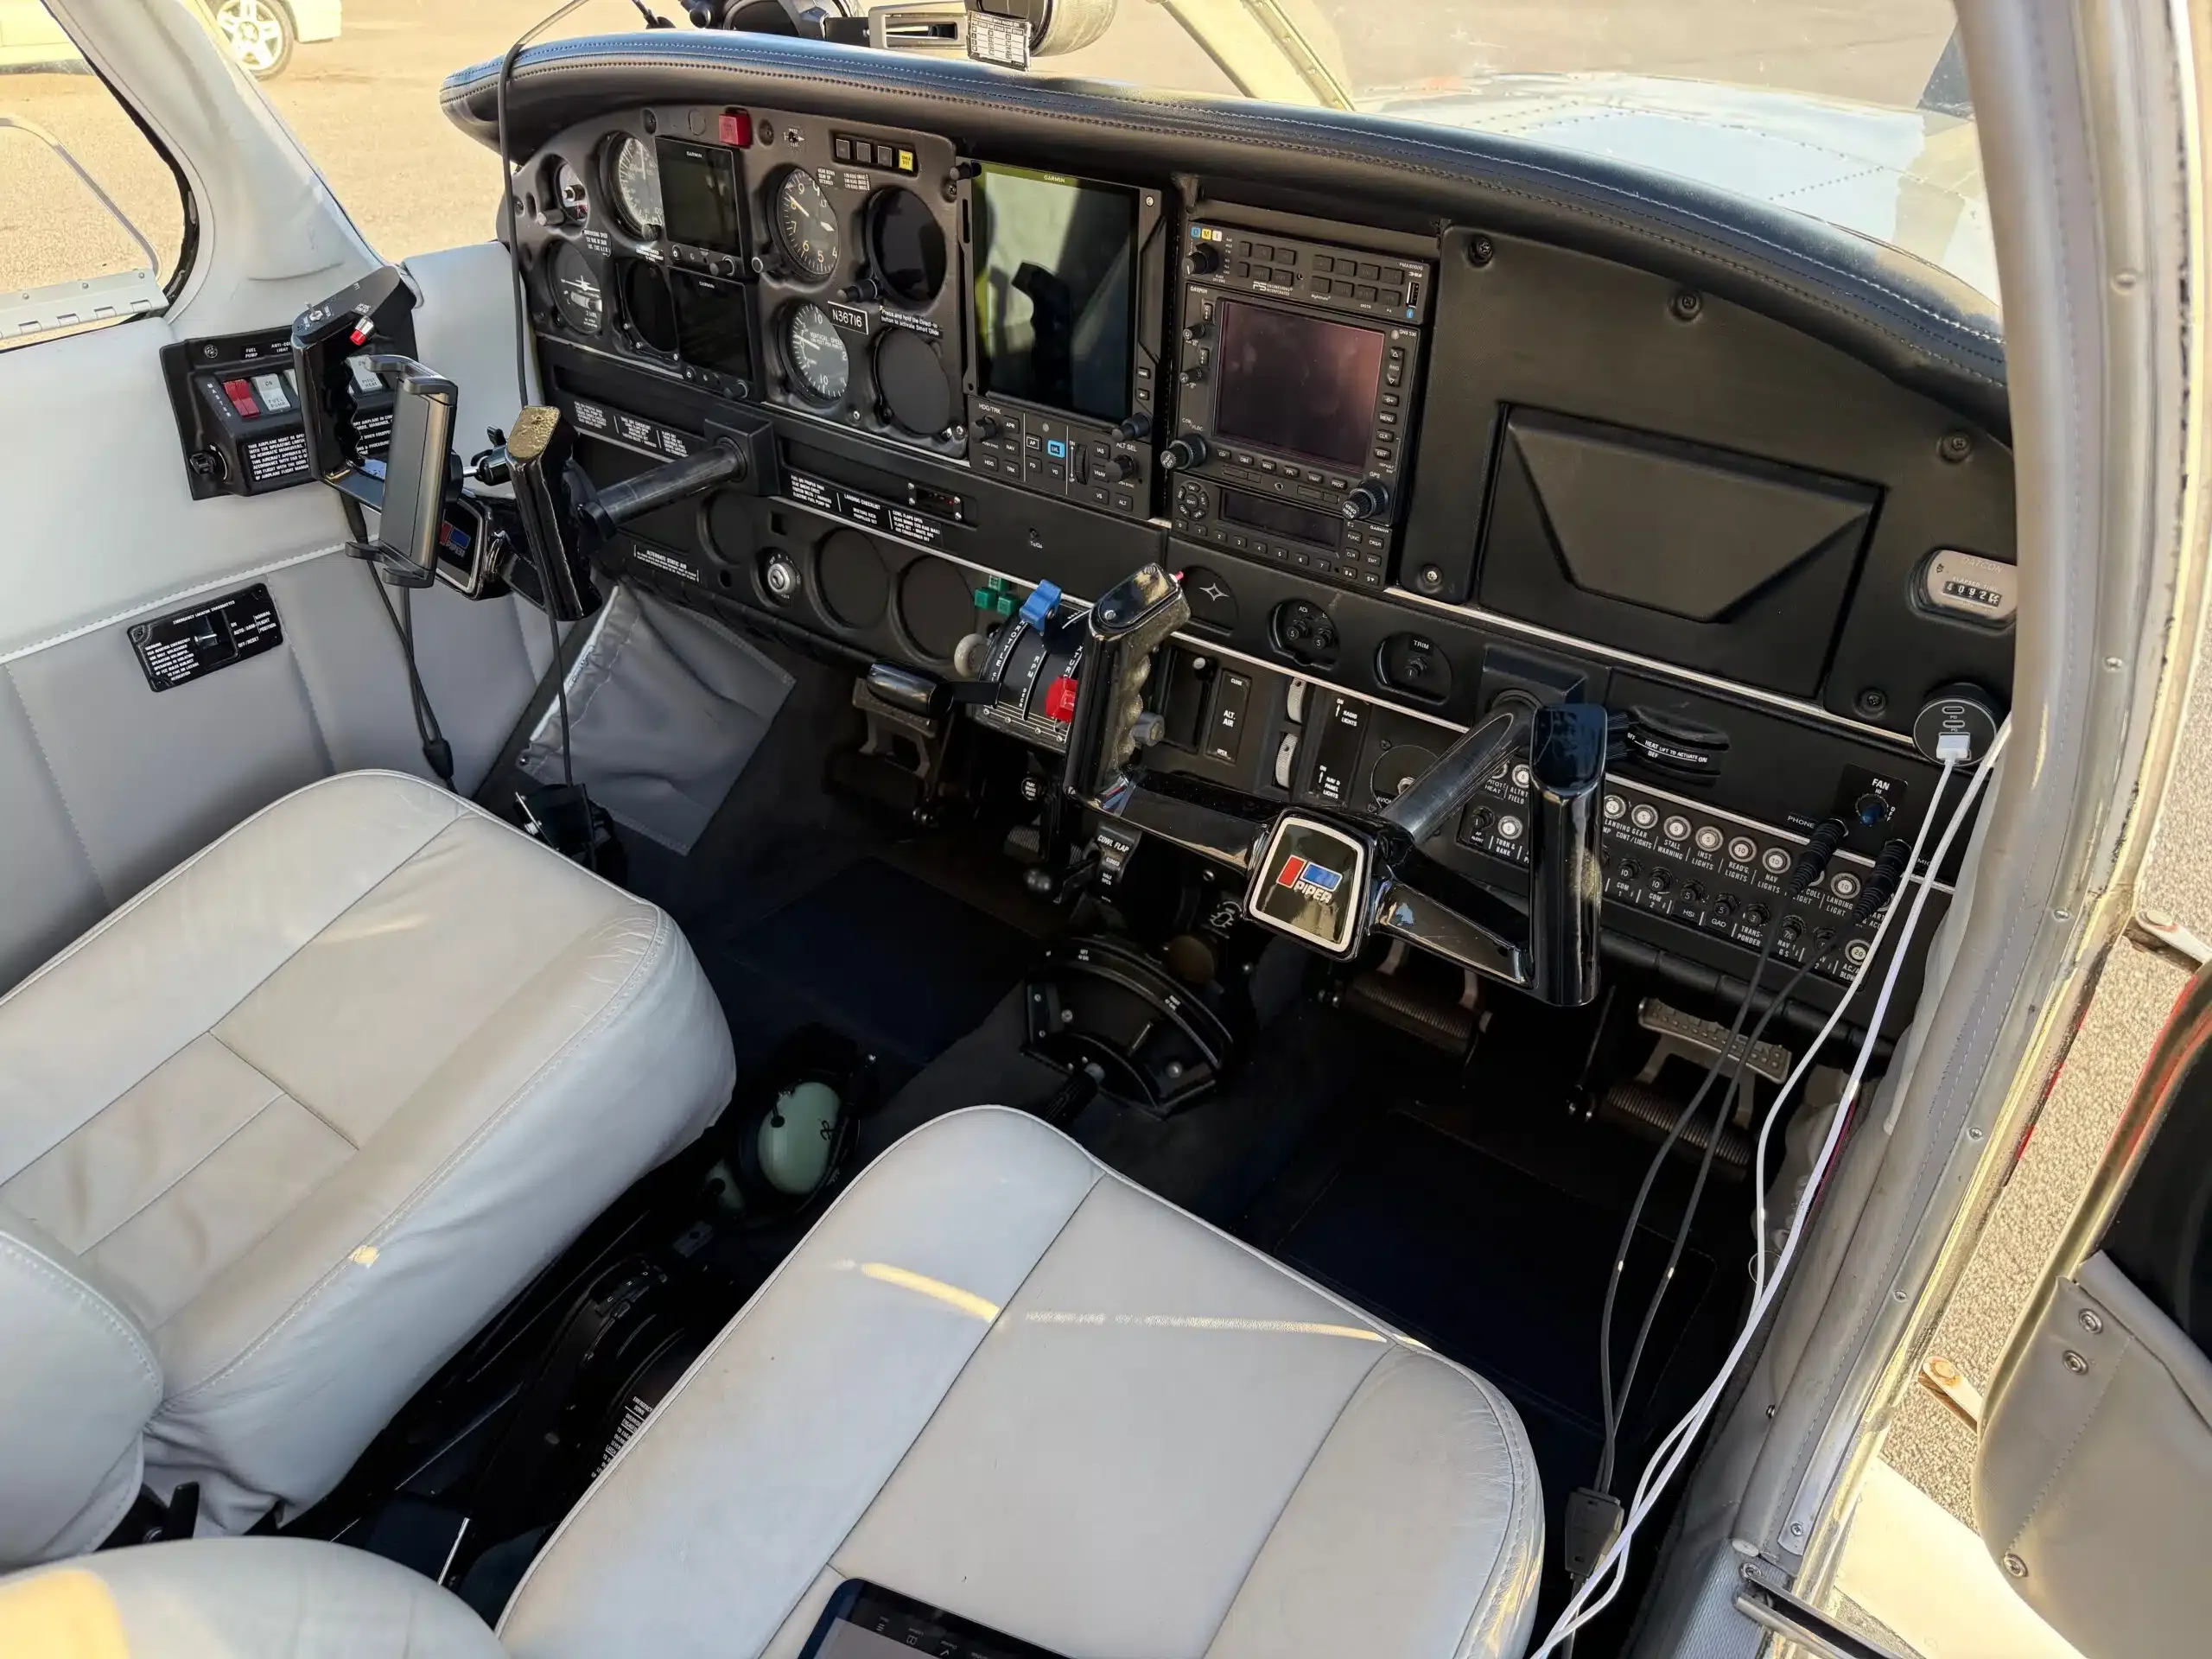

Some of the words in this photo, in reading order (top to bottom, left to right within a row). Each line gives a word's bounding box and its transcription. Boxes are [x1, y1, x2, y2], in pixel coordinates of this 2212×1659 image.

[1044, 175, 1065, 183] GARMIN
[817, 251, 823, 263] 5
[1190, 286, 1208, 295] GARMIN
[814, 314, 823, 324] 10
[832, 309, 862, 327] N36716
[820, 374, 829, 385] 10
[979, 404, 1001, 414] HDG/TRK
[262, 454, 281, 463] AIRCRAFT
[252, 460, 278, 470] ACCORDANCE
[263, 466, 276, 474] FLIGHT
[1953, 576, 1980, 587] ELAPSED
[1413, 639, 1430, 650] TRIM
[1027, 655, 1040, 678] RPM
[1223, 710, 1236, 720] ALT.
[1343, 709, 1358, 720] RADIO
[1223, 718, 1234, 728] AIR
[1341, 716, 1357, 727] LIGHTS
[1627, 732, 1636, 741] OFF
[1645, 740, 1659, 750] HEAT
[1677, 751, 1699, 760] ACTUATE
[1647, 750, 1659, 759] DEF
[1325, 783, 1339, 793] PANEL
[1484, 784, 1502, 794] HEAT
[1872, 778, 1891, 791] FAN
[1323, 789, 1339, 799] LIGHTS
[1508, 794, 1525, 805] FIELD
[1787, 815, 1815, 829] PHONE
[1604, 819, 1630, 833] LANDING
[1631, 828, 1648, 838] GEAR
[1097, 835, 1113, 848] COWL
[1114, 842, 1130, 854] FLAP
[1496, 837, 1510, 849] TURN
[1663, 839, 1681, 850] STALL
[1496, 846, 1511, 856] BANK
[1657, 846, 1683, 861] WARNING
[1697, 850, 1713, 861] INST.
[1691, 858, 1714, 871] LIGHTS
[1725, 868, 1748, 882] LIGHTS
[1764, 874, 1778, 883] NAV
[1616, 881, 1630, 891] COM
[1757, 880, 1781, 894] LIGHTS
[1293, 880, 1332, 904] PIPER
[1649, 892, 1662, 902] COM
[1826, 894, 1853, 910] LANDING
[1682, 909, 1694, 918] HSI
[1826, 906, 1847, 917] LIGHT
[1711, 918, 1726, 928] GAD
[1741, 925, 1764, 938] TRANS-
[1737, 933, 1761, 946] PONDER
[1855, 949, 1864, 957] 20
